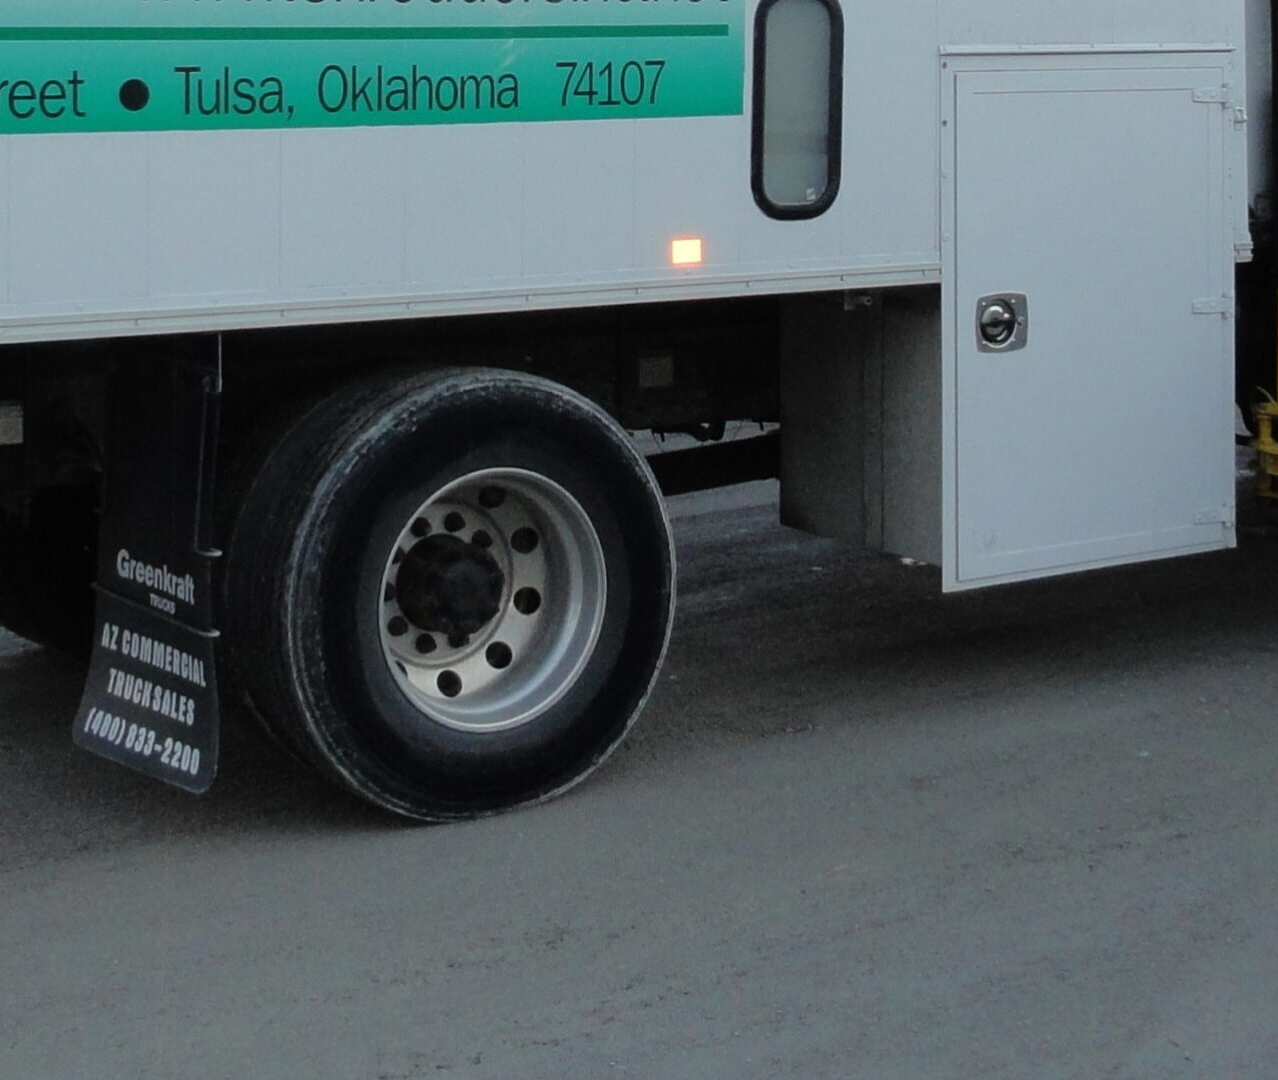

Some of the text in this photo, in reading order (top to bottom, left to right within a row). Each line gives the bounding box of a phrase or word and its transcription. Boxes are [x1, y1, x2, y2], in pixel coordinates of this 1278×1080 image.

[173, 66, 295, 122] Tulsa,
[317, 64, 520, 114] Oklahoma
[555, 60, 666, 108] 74107
[116, 548, 196, 606] Greenkraft
[149, 593, 176, 615] TRUCKS
[101, 622, 207, 688] AZ COMMERCIAL
[125, 723, 201, 776] 833-2200
